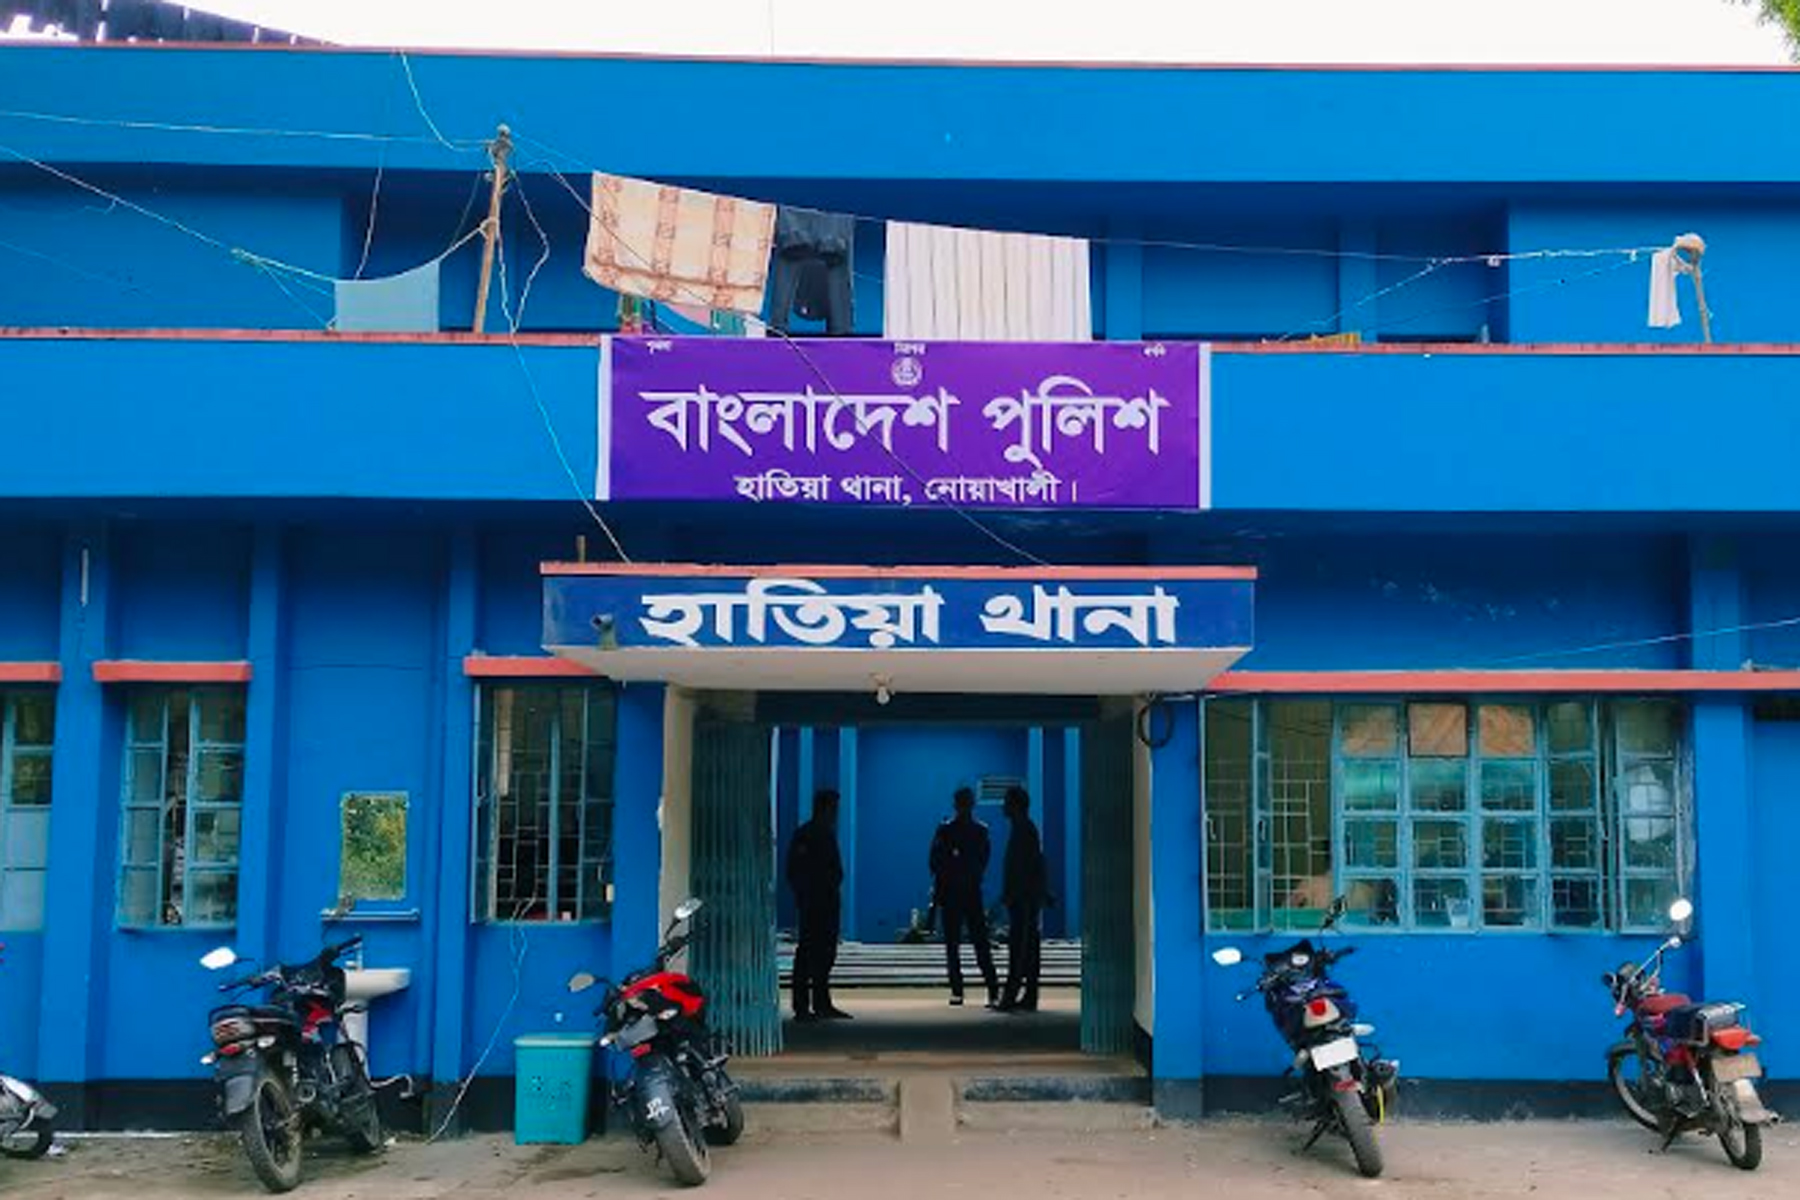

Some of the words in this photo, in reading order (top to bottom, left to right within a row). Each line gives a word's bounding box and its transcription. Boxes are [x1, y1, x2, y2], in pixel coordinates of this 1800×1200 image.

[639, 384, 961, 455] বাংলাদেশ
[983, 375, 1171, 466] পুলিশ
[734, 469, 831, 503] হাতিয়া
[840, 474, 912, 505] থানা,
[925, 470, 1062, 503] নোয়াখালী
[640, 577, 945, 649] হাতিয়া
[980, 584, 1180, 645] থানা
